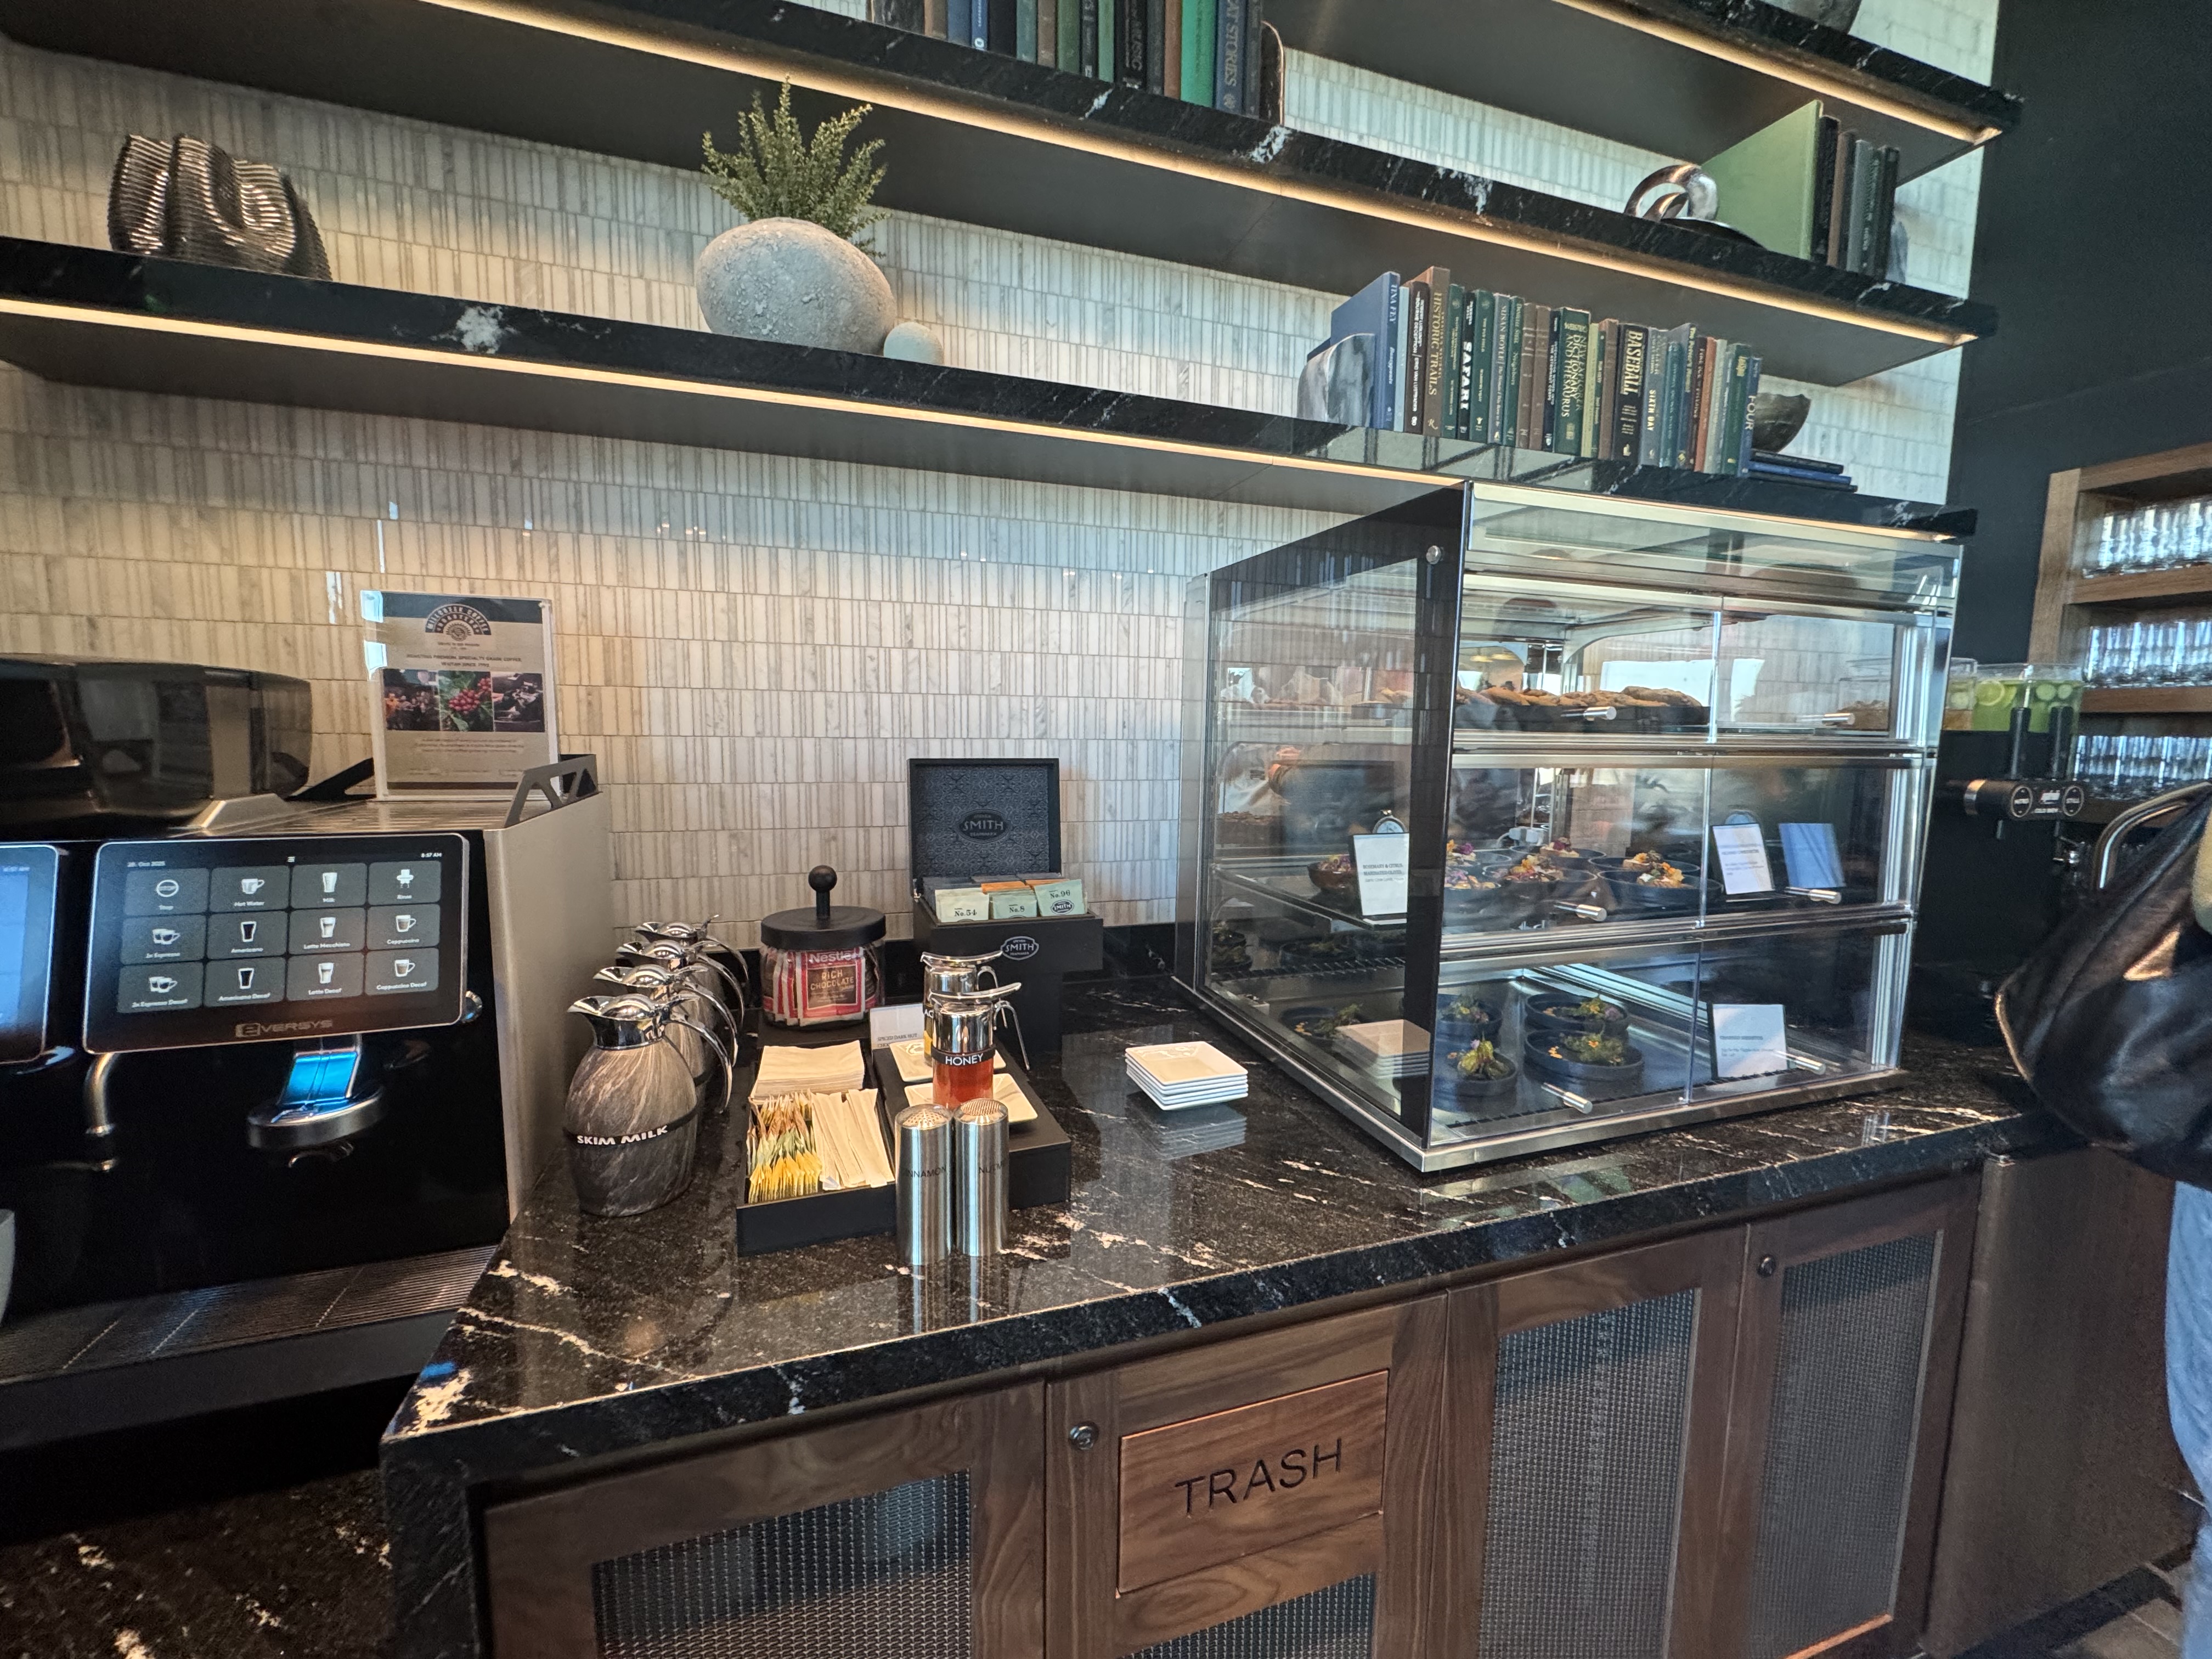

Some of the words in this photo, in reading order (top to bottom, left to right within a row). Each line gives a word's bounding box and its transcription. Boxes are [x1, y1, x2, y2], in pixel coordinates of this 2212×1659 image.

[1225, 22, 1238, 87] STORIES
[1431, 292, 1442, 349] HISTORIC
[1565, 334, 1574, 357] AND
[1429, 352, 1439, 395] TRAILS
[1570, 334, 1581, 399] DICTIONARY
[1623, 330, 1643, 396] BASEBALL
[1460, 341, 1472, 410] SAFARI
[1575, 361, 1586, 411] EXPLORER
[1561, 359, 1572, 417] THESAURUS
[1647, 389, 1656, 413] SIXTH
[1745, 395, 1757, 430] FOUR
[1646, 416, 1655, 431] DAY
[963, 820, 1003, 831] SMITH
[387, 938, 420, 946] Cappuccino
[1005, 943, 1034, 952] SMITH
[810, 977, 854, 990] CHOCOLATE
[822, 969, 843, 980] RICH
[252, 991, 271, 1000] Decaf
[376, 983, 410, 991] Cappuccino
[945, 1053, 984, 1066] HONEY
[577, 1135, 616, 1146] SKIM
[620, 1125, 668, 1144] MILK
[1175, 1437, 1342, 1514] TRASH
